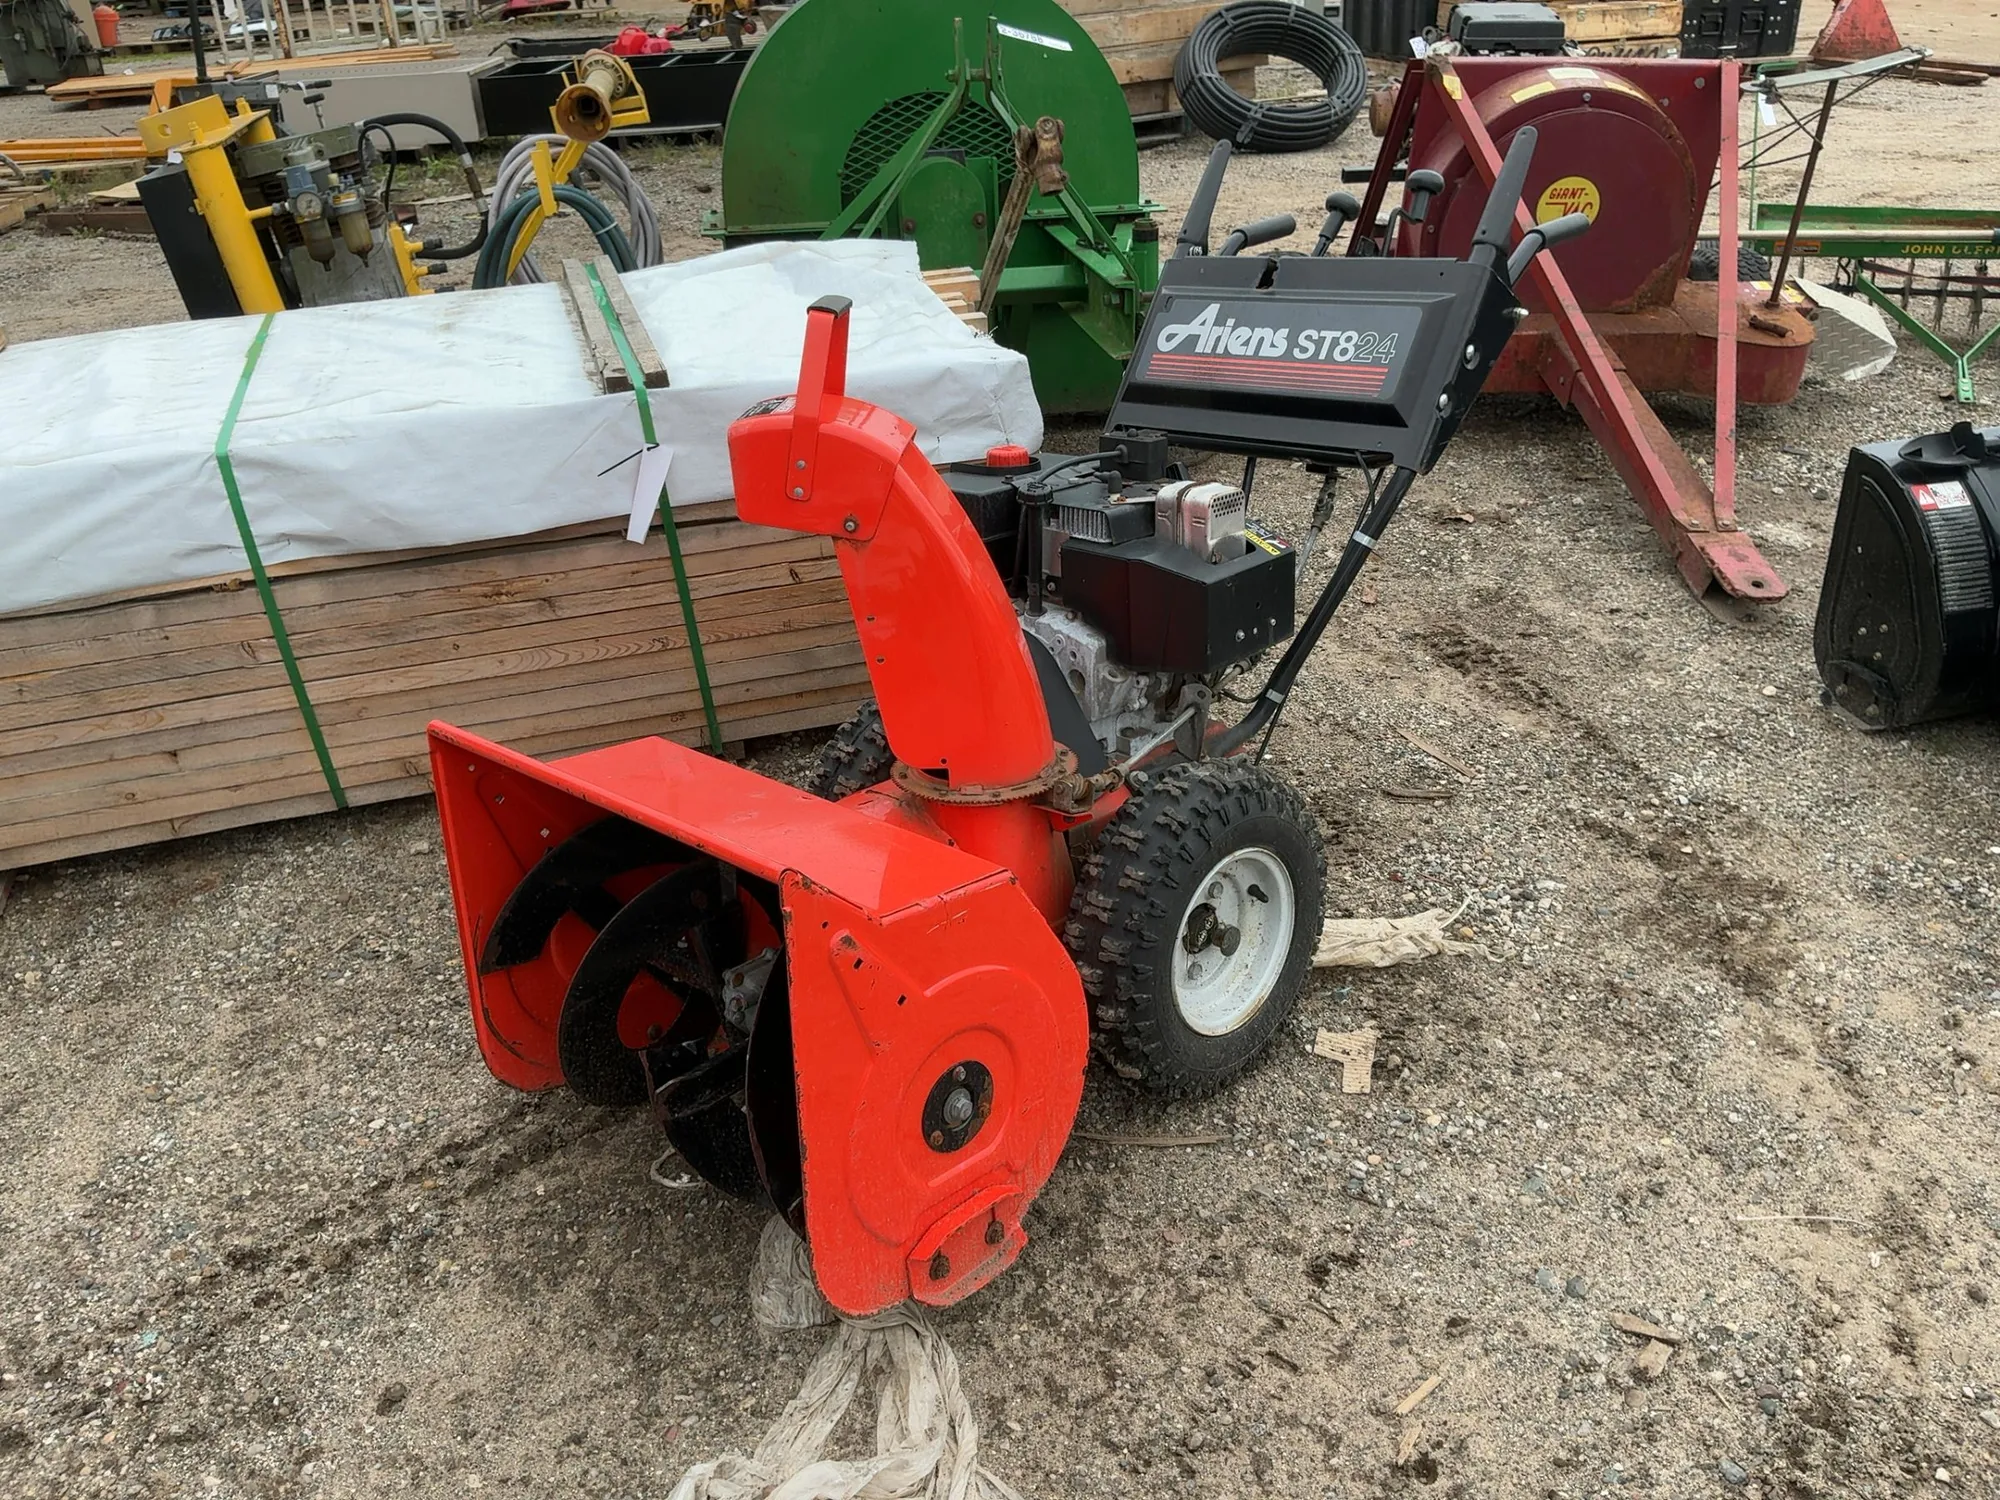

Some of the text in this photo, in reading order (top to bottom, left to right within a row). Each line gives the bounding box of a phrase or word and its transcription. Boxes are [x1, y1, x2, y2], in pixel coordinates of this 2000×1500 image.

[1549, 187, 1589, 199] GIANT-
[1901, 244, 1945, 254] JOHN
[1157, 303, 1399, 363] Ariens ST824
